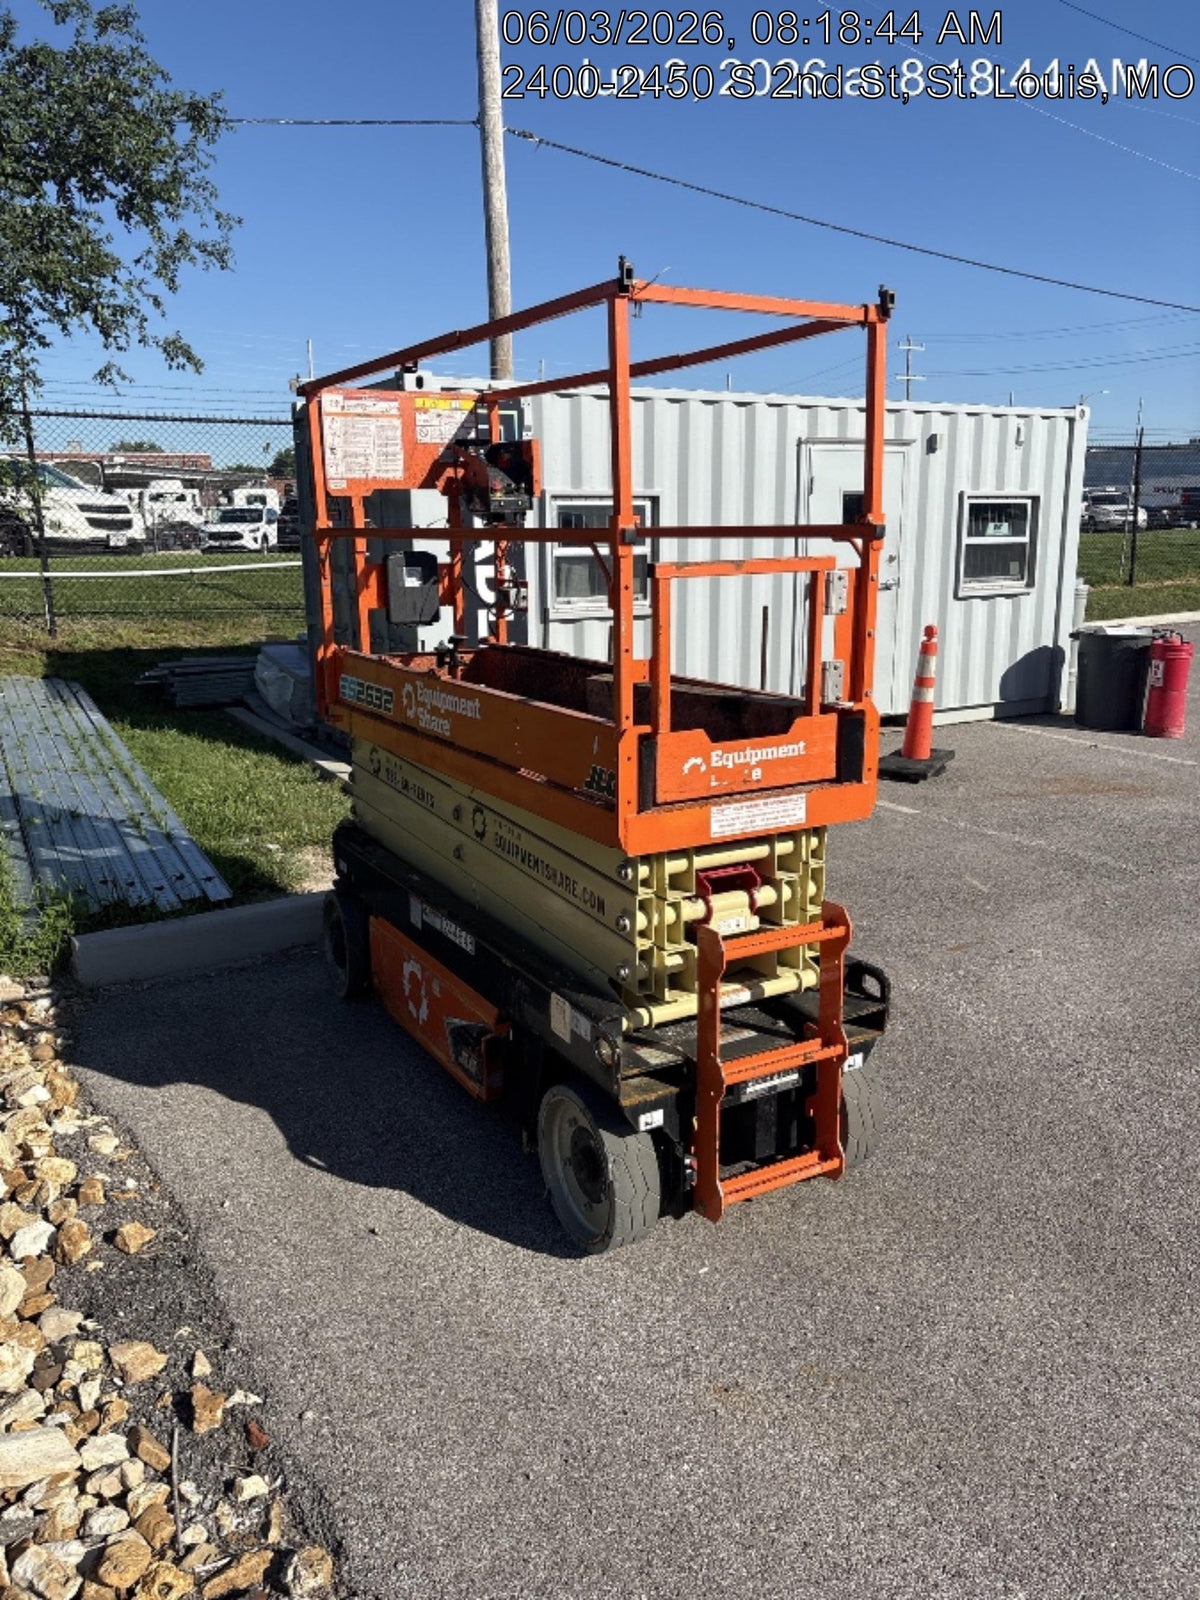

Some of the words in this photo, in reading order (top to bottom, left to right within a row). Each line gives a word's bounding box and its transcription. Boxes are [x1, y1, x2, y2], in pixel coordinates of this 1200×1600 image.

[416, 680, 481, 719] Equipment
[418, 707, 452, 736] Share
[710, 740, 806, 768] Equipment
